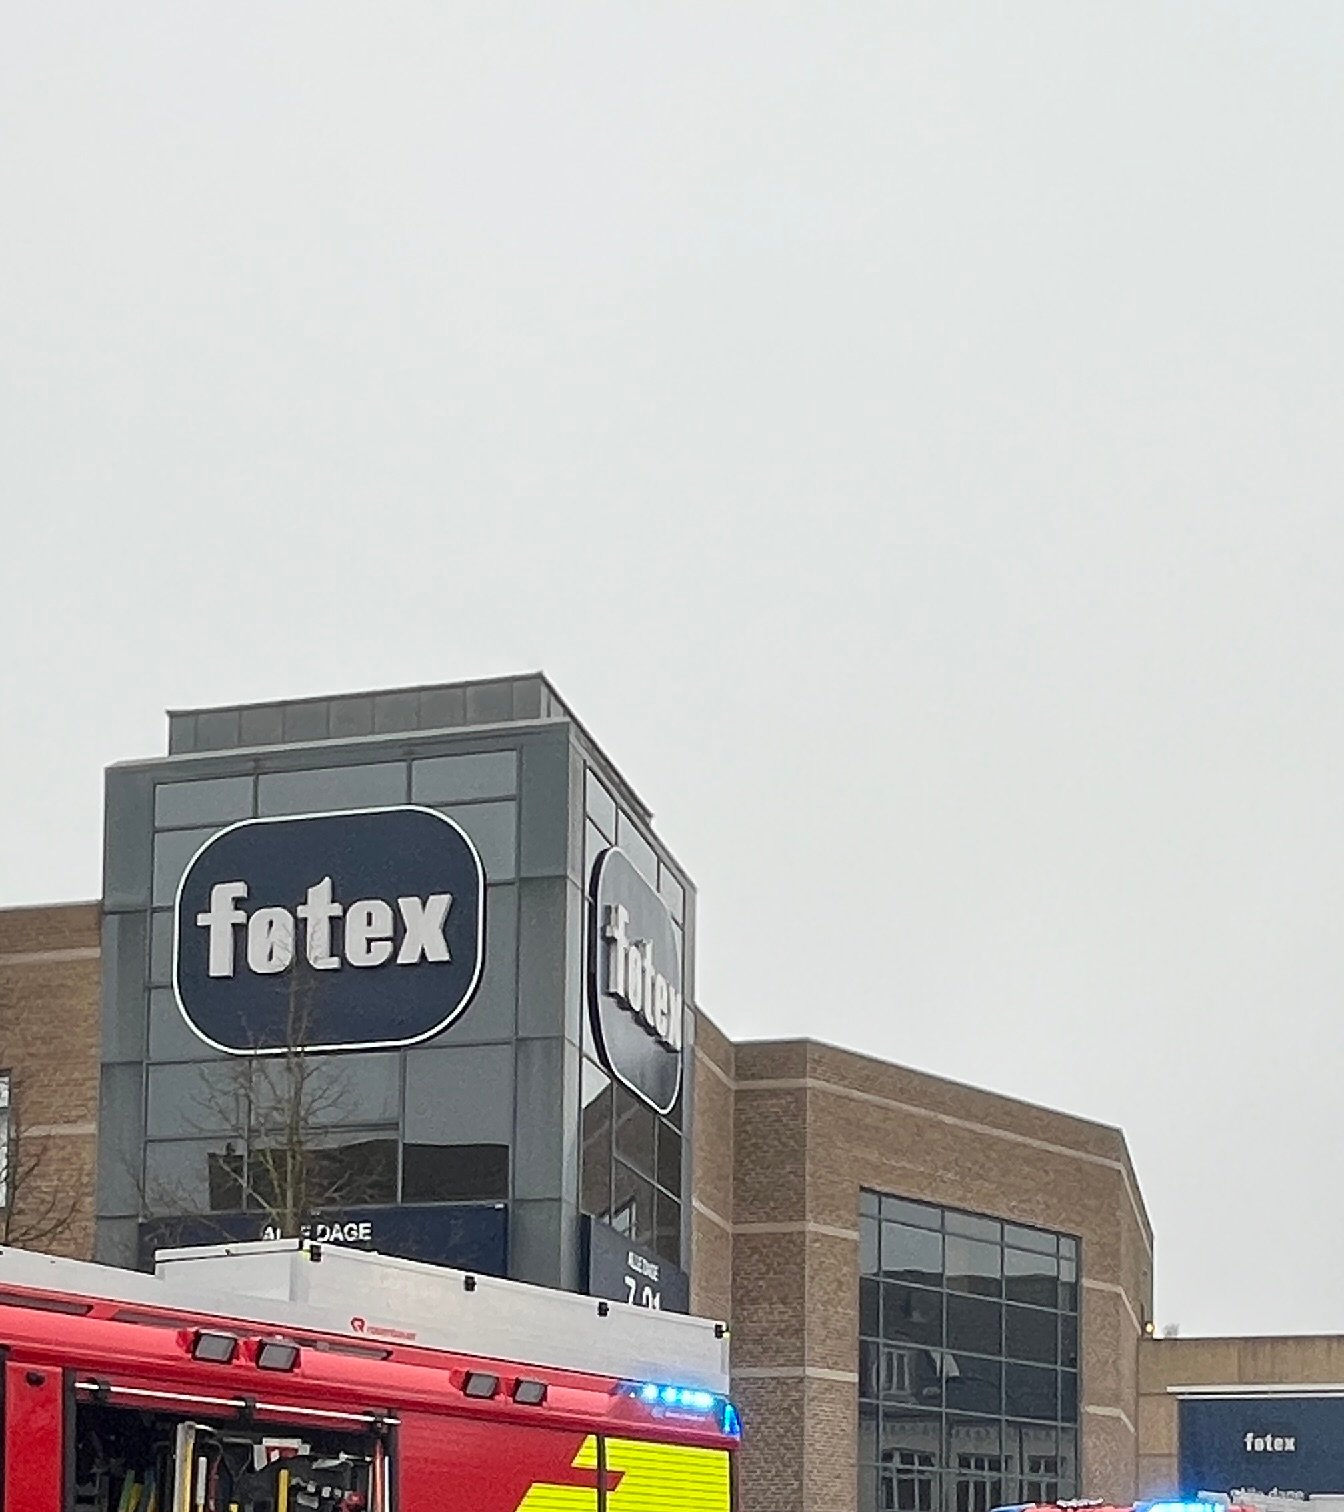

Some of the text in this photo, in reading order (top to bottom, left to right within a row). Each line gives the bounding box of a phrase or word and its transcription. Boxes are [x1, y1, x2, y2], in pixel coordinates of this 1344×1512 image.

[196, 876, 453, 978] føtex
[605, 904, 682, 1051] føtex
[316, 1223, 372, 1242] DAGE
